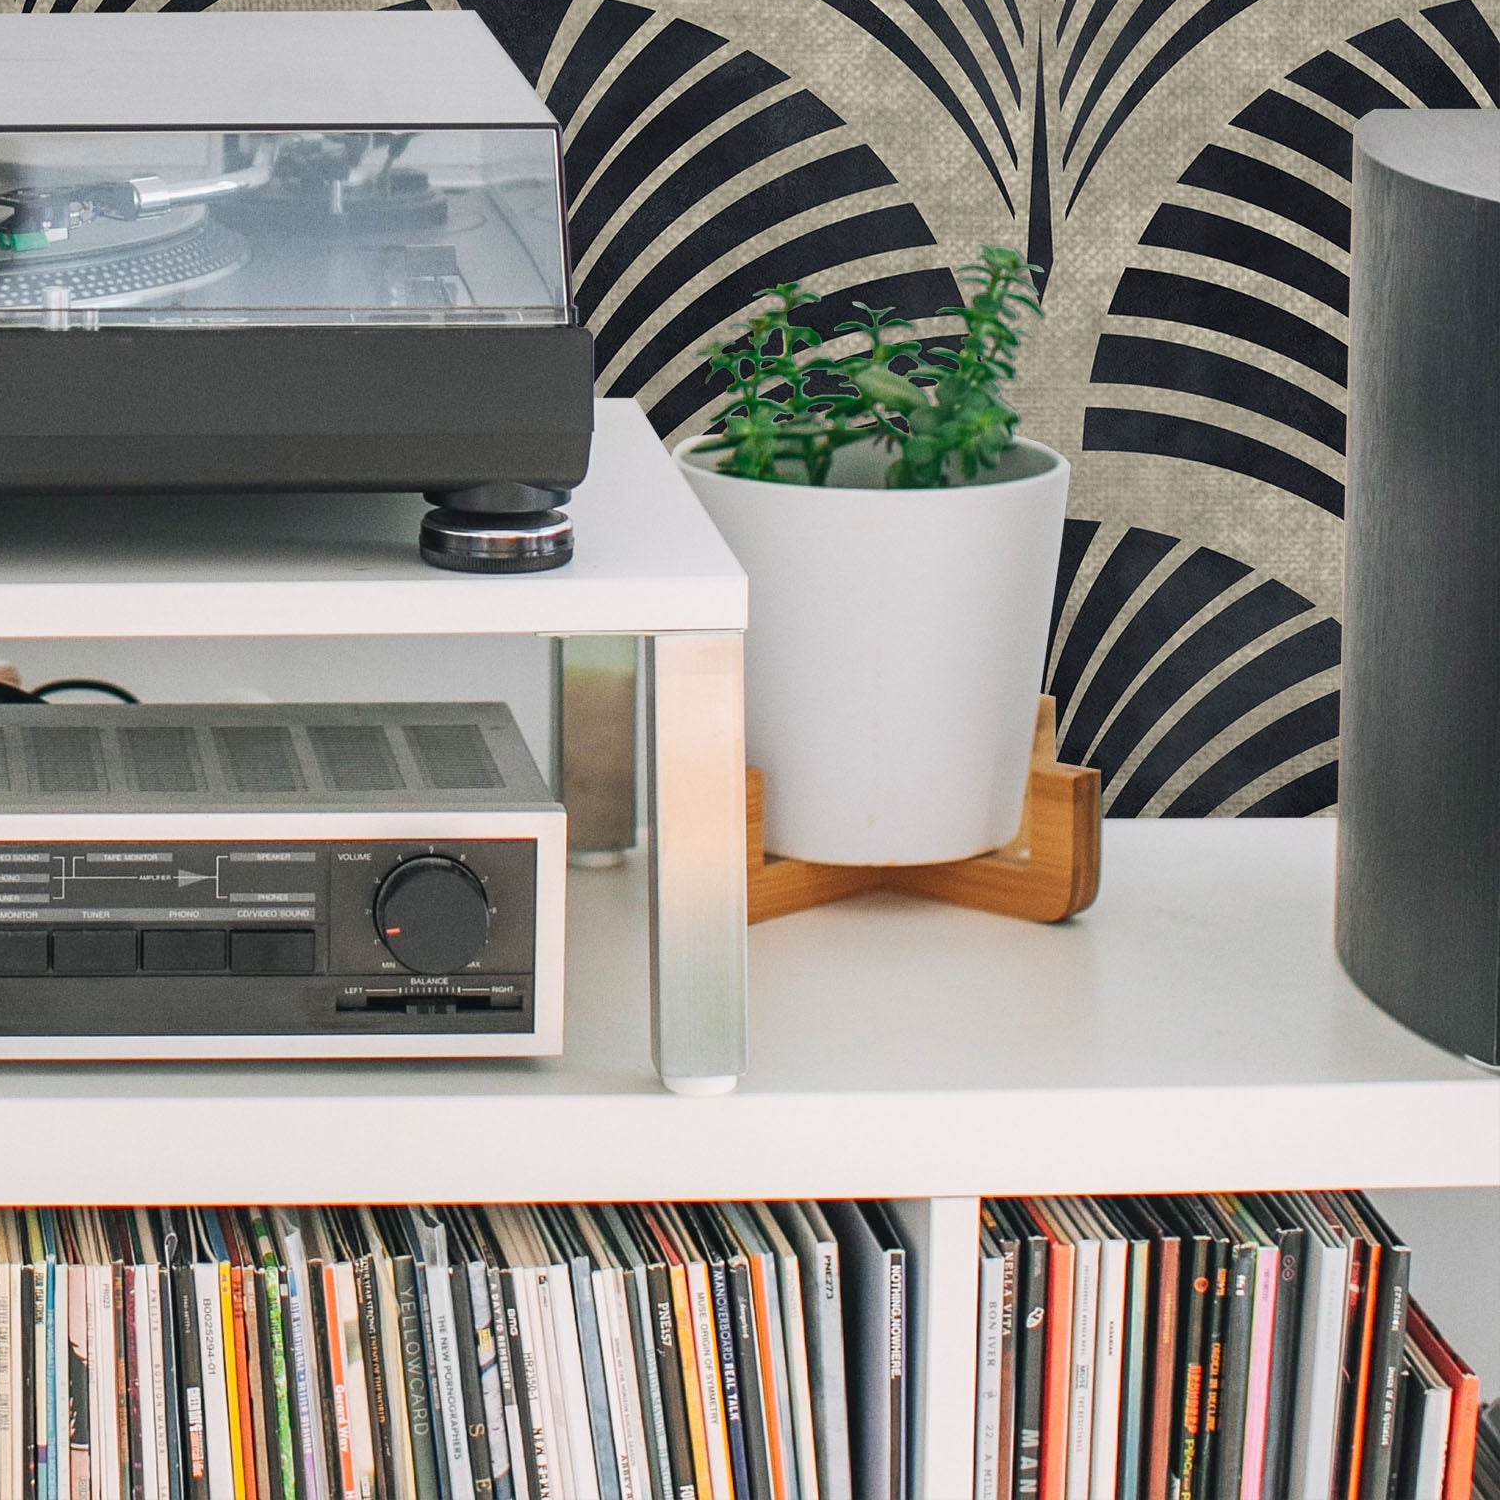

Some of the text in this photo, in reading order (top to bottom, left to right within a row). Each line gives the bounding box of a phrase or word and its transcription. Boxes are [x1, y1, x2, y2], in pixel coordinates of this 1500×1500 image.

[257, 852, 291, 860] SPEAKER
[337, 853, 372, 861] VOLUME
[0, 911, 38, 919] MONITOR
[169, 910, 200, 918] PHONO
[237, 910, 309, 918] CD/VIDEO SOUND
[410, 977, 449, 985] BALANCE
[363, 1280, 372, 1299] YEAR
[824, 1254, 834, 1300] PNE273
[34, 1271, 45, 1325] FOUR YEAR STRONG
[1002, 1251, 1014, 1336] NELLA VITA
[365, 1300, 375, 1334] STRONG
[507, 1308, 518, 1337] BMG
[657, 1302, 673, 1347] PNE157
[987, 1300, 997, 1333] BON
[203, 1298, 216, 1375] B0025294-01
[370, 1335, 379, 1362] ENEMY
[490, 1283, 512, 1390] A DAY TO REMEMBER
[700, 1324, 712, 1357] ORIGIN
[987, 1336, 997, 1367] IVER
[1107, 1321, 1115, 1356] KASABIAN
[0, 1346, 10, 1374] CALLING
[372, 1363, 380, 1372] OF
[399, 1287, 429, 1436] YELLOWCARD
[704, 1359, 713, 1372] OF
[1380, 1285, 1403, 1447] grandson Death Of An Optimist
[374, 1376, 382, 1392] THE
[438, 1315, 460, 1460] THE NEW PORNOGRAPHERS
[524, 1352, 539, 1402] HR2350-1
[724, 1362, 736, 1389] REAL
[1078, 1365, 1088, 1389] MUSE
[0, 1394, 10, 1432] CONTENDER
[335, 1384, 347, 1423] Gerard
[375, 1393, 386, 1423] WORLD
[705, 1373, 719, 1425] SYMMETRY
[727, 1393, 740, 1422] TALK
[338, 1426, 350, 1453] Way
[627, 1440, 636, 1467] SEASON
[984, 1453, 993, 1462] A
[1019, 1428, 1040, 1494] MAN
